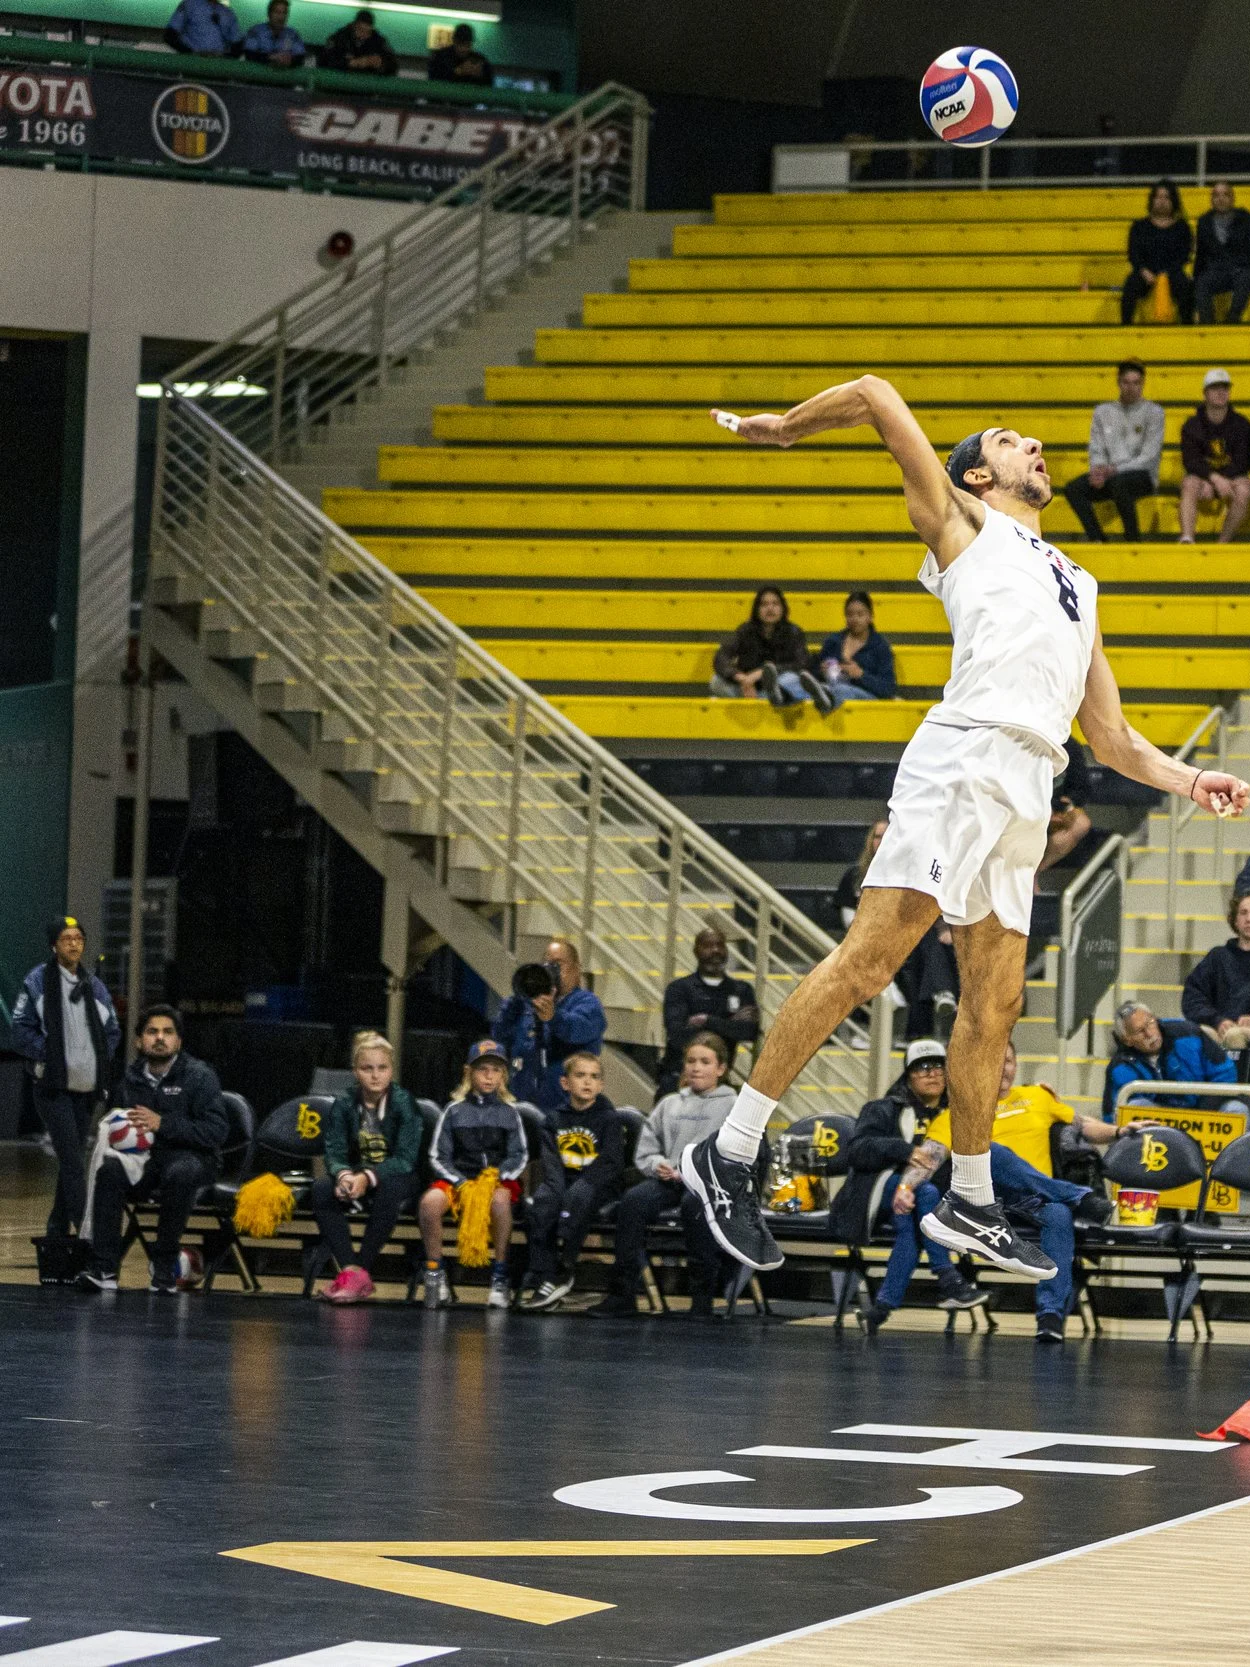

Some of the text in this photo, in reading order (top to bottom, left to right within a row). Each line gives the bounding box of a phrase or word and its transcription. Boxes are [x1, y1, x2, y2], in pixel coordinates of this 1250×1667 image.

[0, 74, 94, 117] OTA
[929, 82, 958, 98] molten
[934, 100, 966, 121] NCAA
[18, 119, 87, 146] 1966
[160, 112, 222, 133] TOYOTA
[294, 104, 496, 153] CABE
[297, 152, 343, 172] LONG
[349, 157, 404, 177] BEACH,
[1208, 1122, 1233, 1135] 110
